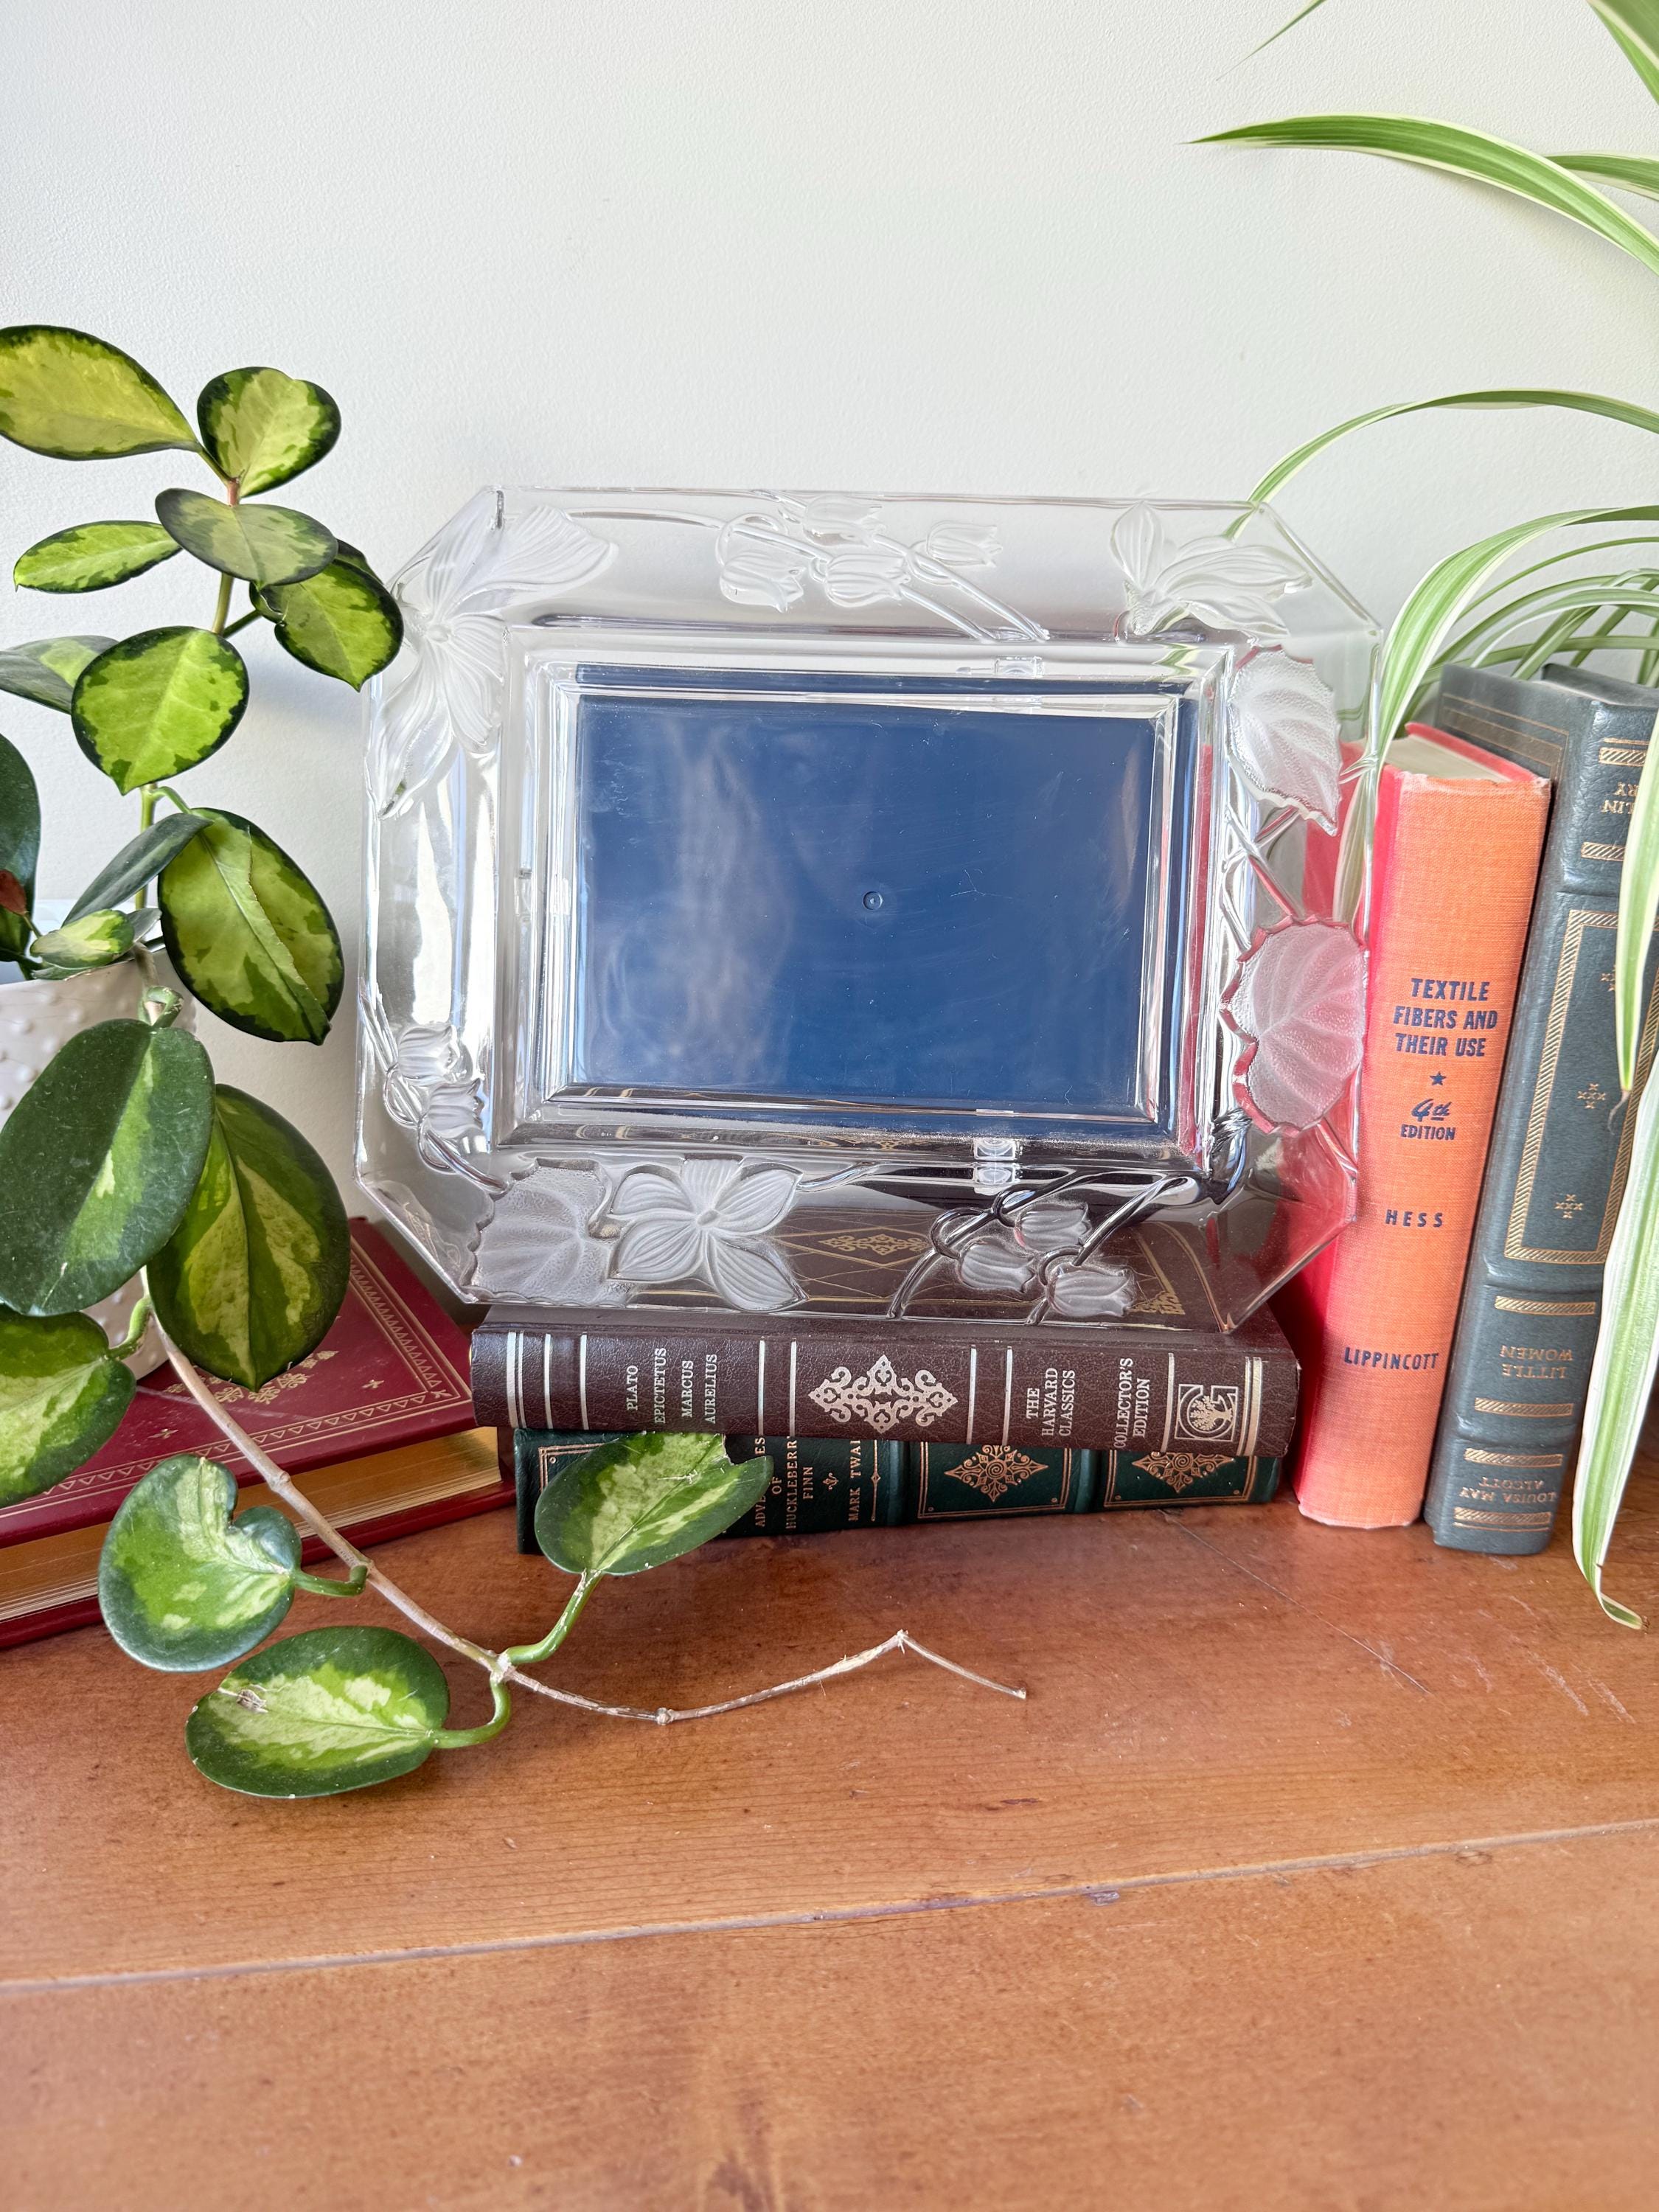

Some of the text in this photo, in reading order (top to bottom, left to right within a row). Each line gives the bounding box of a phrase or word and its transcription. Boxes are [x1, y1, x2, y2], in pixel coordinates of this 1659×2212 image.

[1411, 978, 1490, 1001] TEXTILE
[1393, 1006, 1498, 1030] FIBERS AND
[1395, 1032, 1486, 1057] THEIR USE
[1411, 1098, 1452, 1121] 4th
[1400, 1124, 1455, 1141] EDITION
[1385, 1209, 1443, 1228] HESS
[1344, 1347, 1439, 1370] LIPPINCOTT
[1499, 1345, 1572, 1361] WOMEN
[654, 1348, 667, 1425] EPICTETUS
[1502, 1363, 1567, 1379] LITTLE
[626, 1365, 639, 1411] PLATO
[681, 1360, 693, 1418] MARCUS
[704, 1354, 717, 1424] AURELIUS
[1026, 1388, 1040, 1419] THE
[1041, 1367, 1058, 1436] HARVARD
[1058, 1370, 1076, 1436] CLASSICS
[1113, 1357, 1133, 1448] COLLECTOR'S
[1133, 1378, 1150, 1437] EDITION
[754, 1437, 766, 1527] ADVEES
[772, 1476, 782, 1495] OF
[785, 1436, 798, 1528] HUCKLEBERR
[803, 1467, 813, 1500] FINN
[849, 1440, 861, 1521] MARK TWAI
[1459, 1486, 1557, 1503] LOUISA MAY
[1479, 1476, 1543, 1490] ALCOTT
